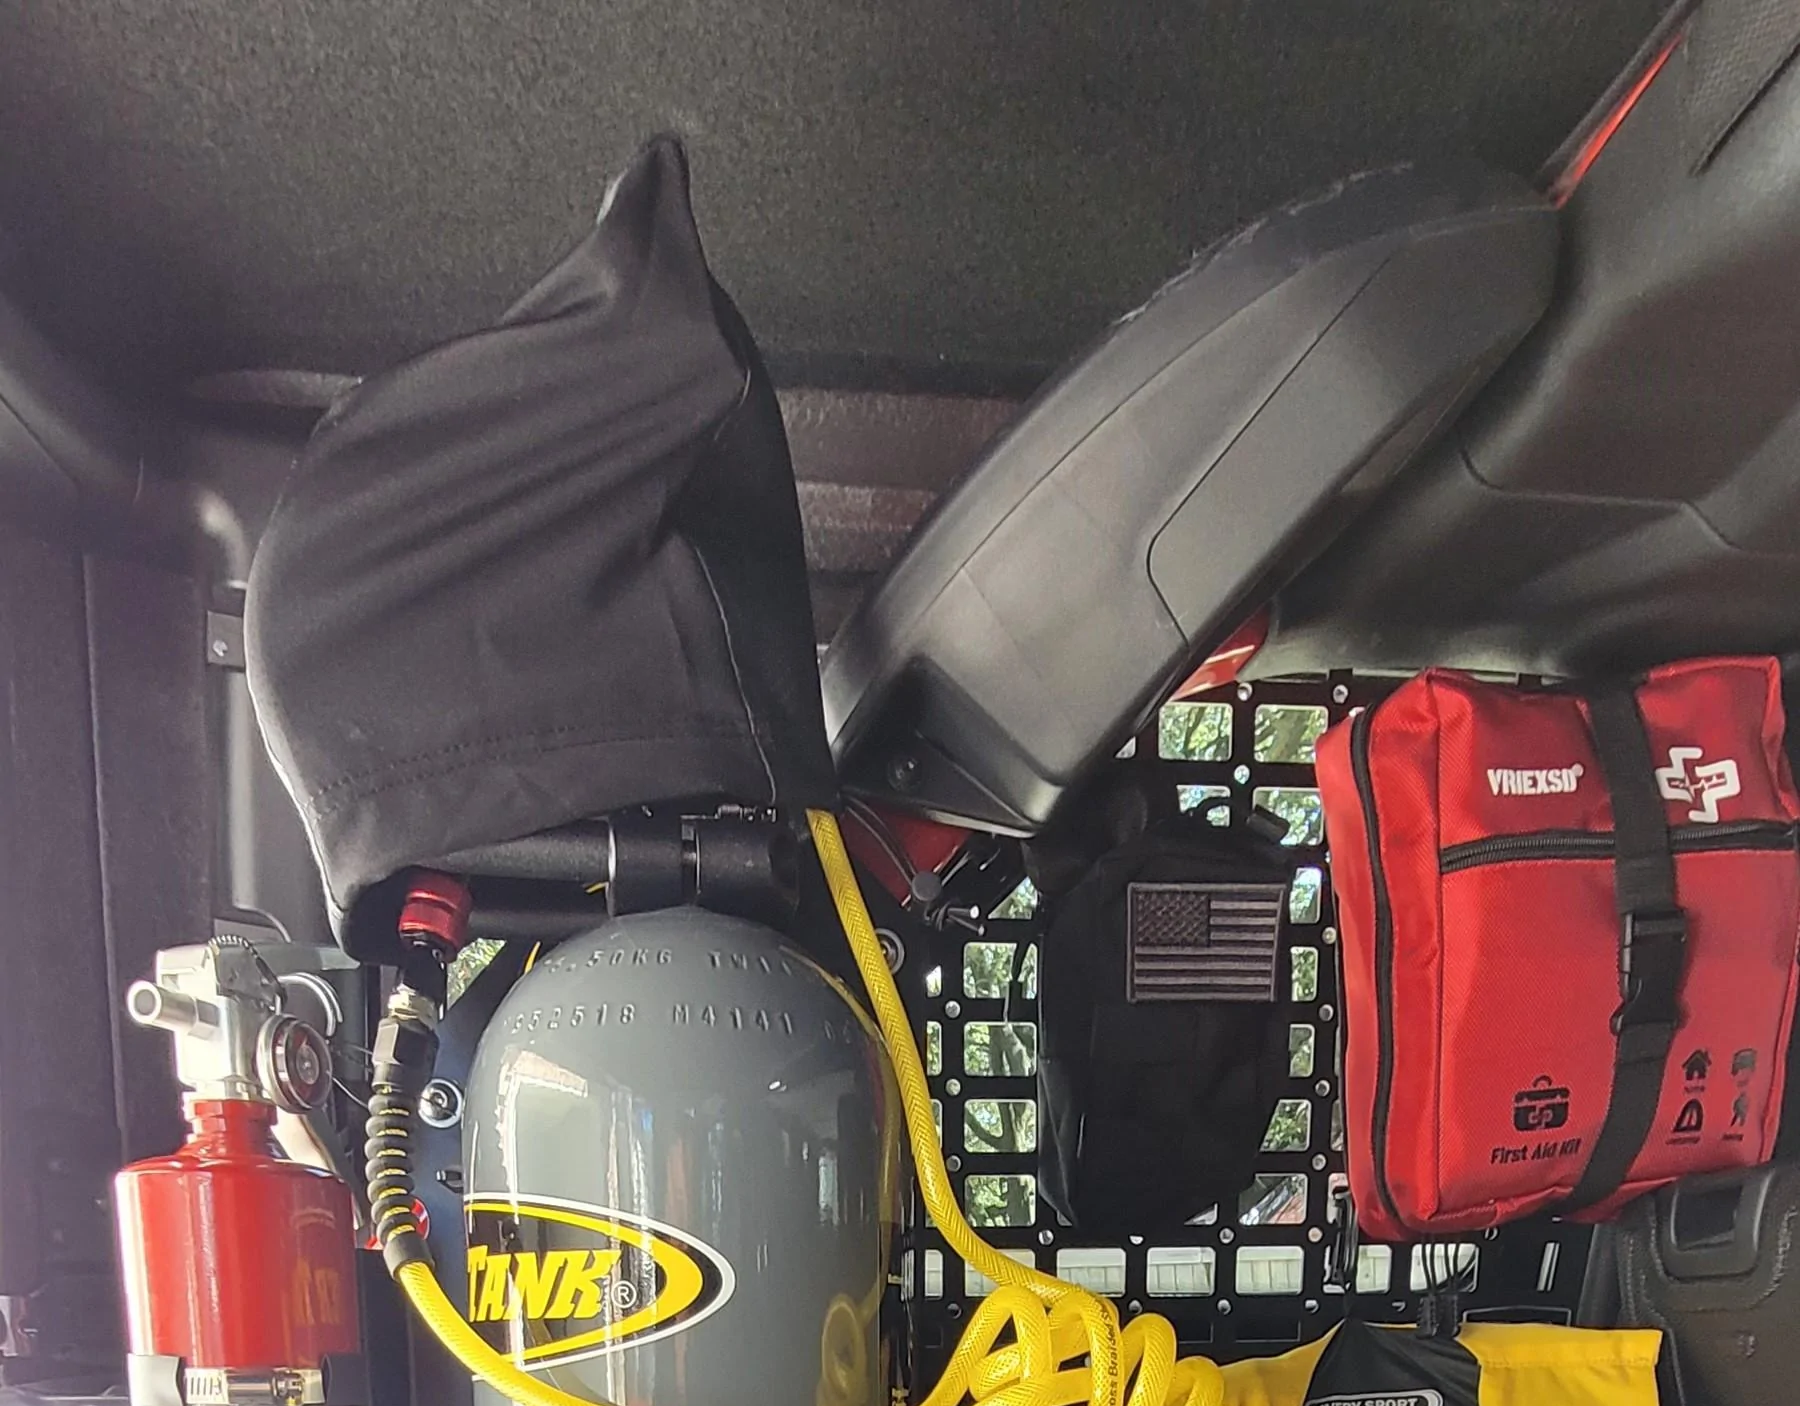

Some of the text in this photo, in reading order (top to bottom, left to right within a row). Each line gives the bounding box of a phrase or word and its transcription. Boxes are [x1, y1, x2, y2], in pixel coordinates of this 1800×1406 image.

[1491, 1145, 1528, 1164] First
[1531, 1142, 1558, 1161] Aid
[467, 1245, 621, 1323] TANK
[1104, 1324, 1120, 1377] Braided
